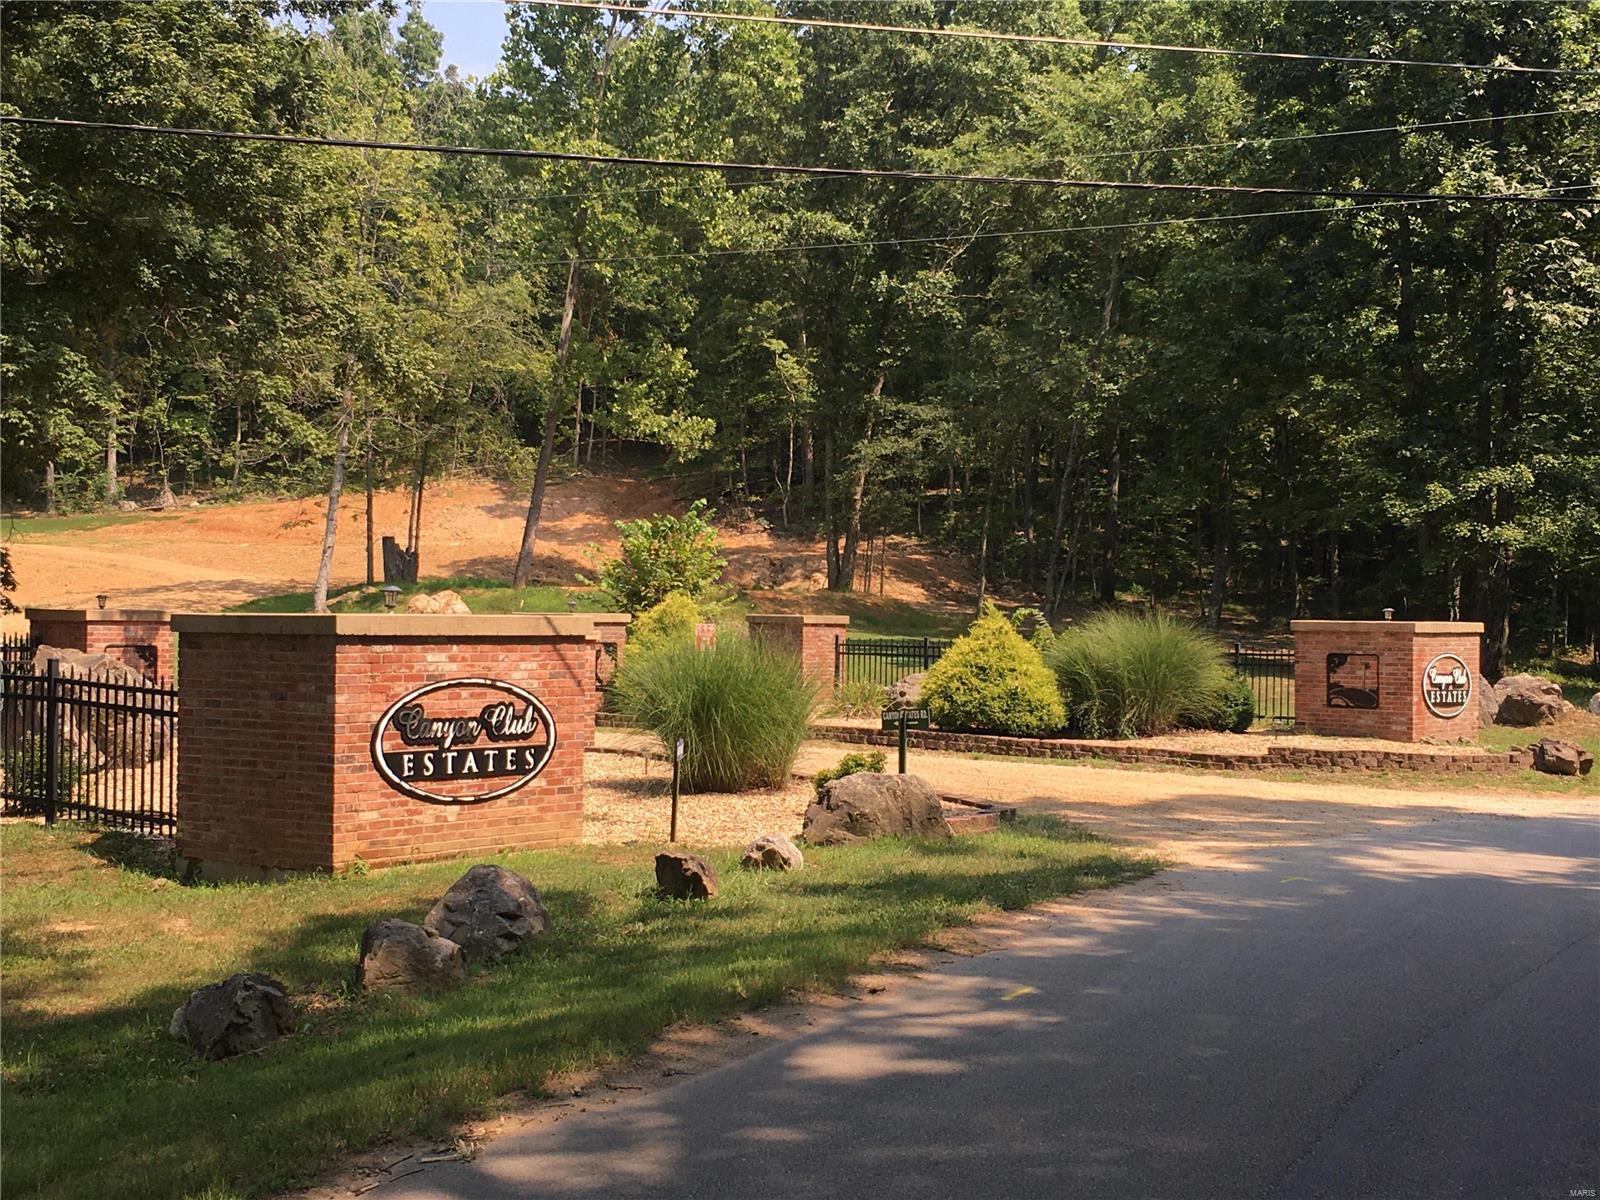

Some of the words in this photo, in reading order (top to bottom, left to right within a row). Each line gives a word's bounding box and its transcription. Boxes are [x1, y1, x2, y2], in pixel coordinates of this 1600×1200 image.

[1430, 690, 1467, 703] ESTATES
[399, 706, 482, 748] Canyon
[484, 704, 538, 736] Club
[402, 748, 535, 777] ESTATES
